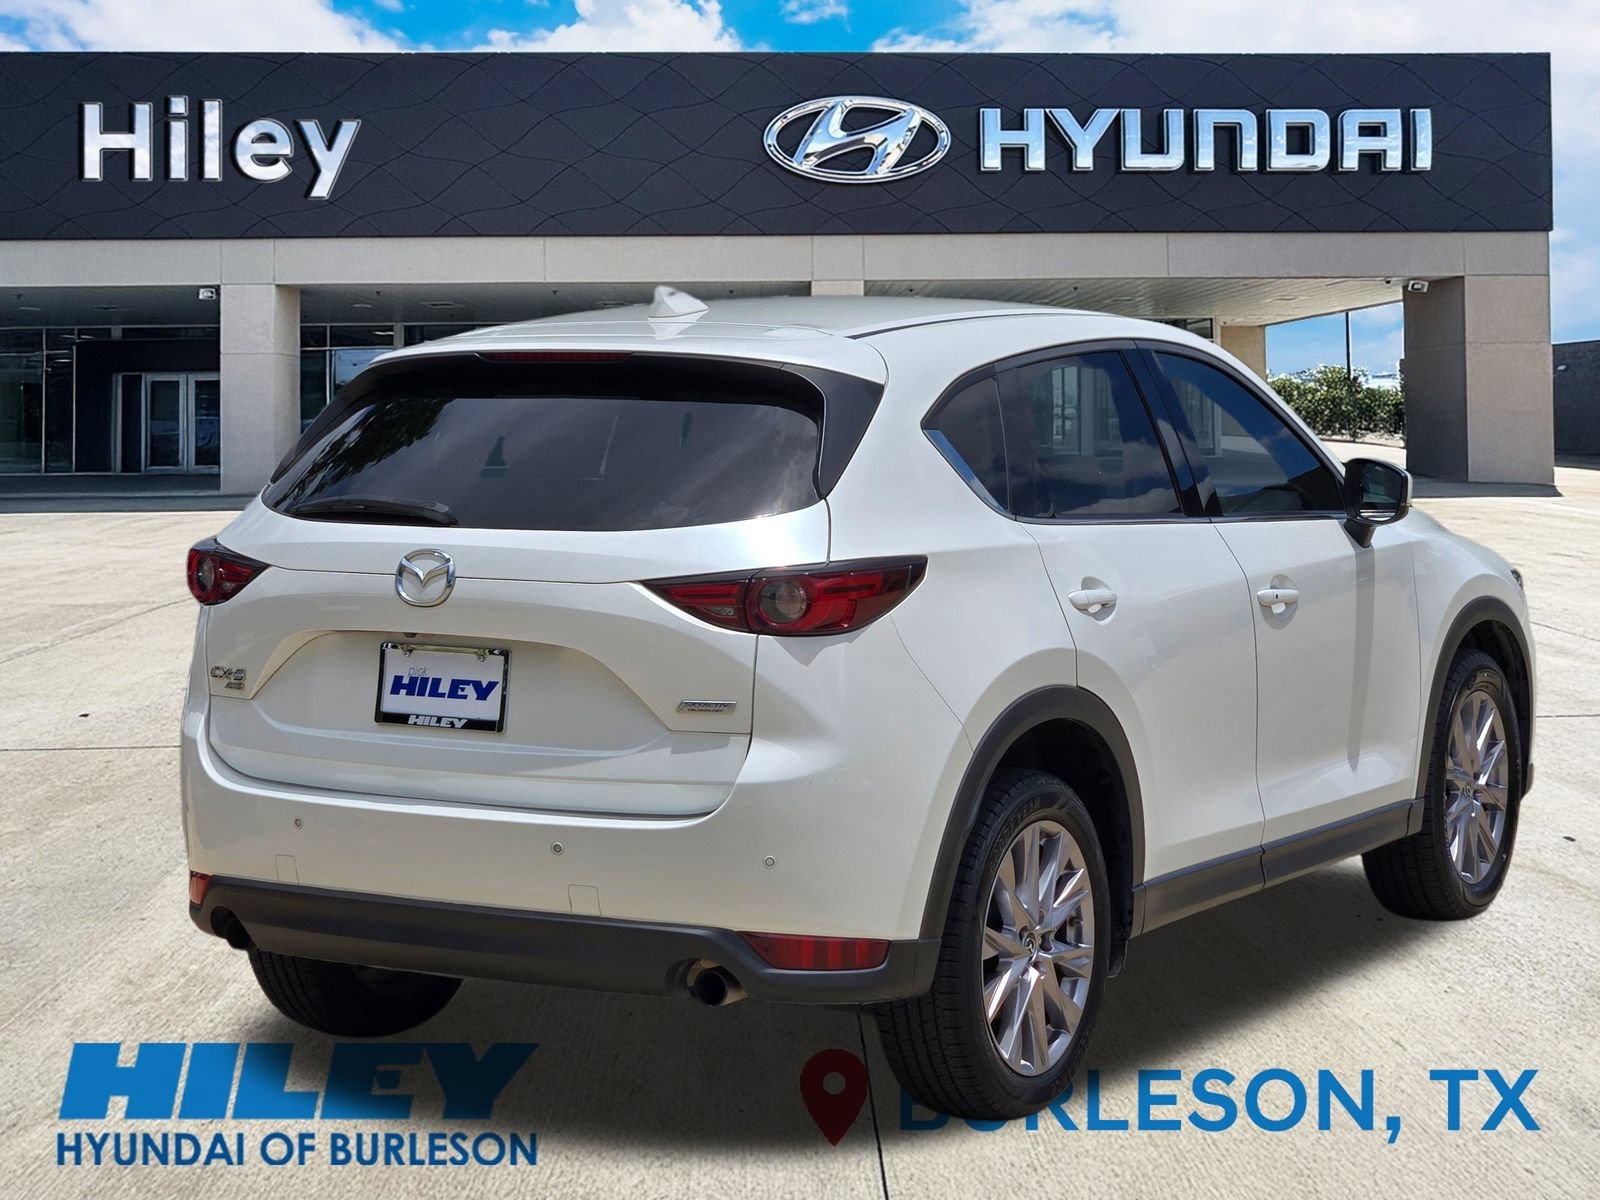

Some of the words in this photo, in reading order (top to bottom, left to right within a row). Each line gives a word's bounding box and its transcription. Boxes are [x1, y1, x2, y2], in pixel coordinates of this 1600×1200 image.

[79, 95, 361, 199] Hiley
[980, 107, 1433, 172] HYUNDAI
[389, 674, 499, 701] HILEY
[408, 714, 468, 729] HILEY
